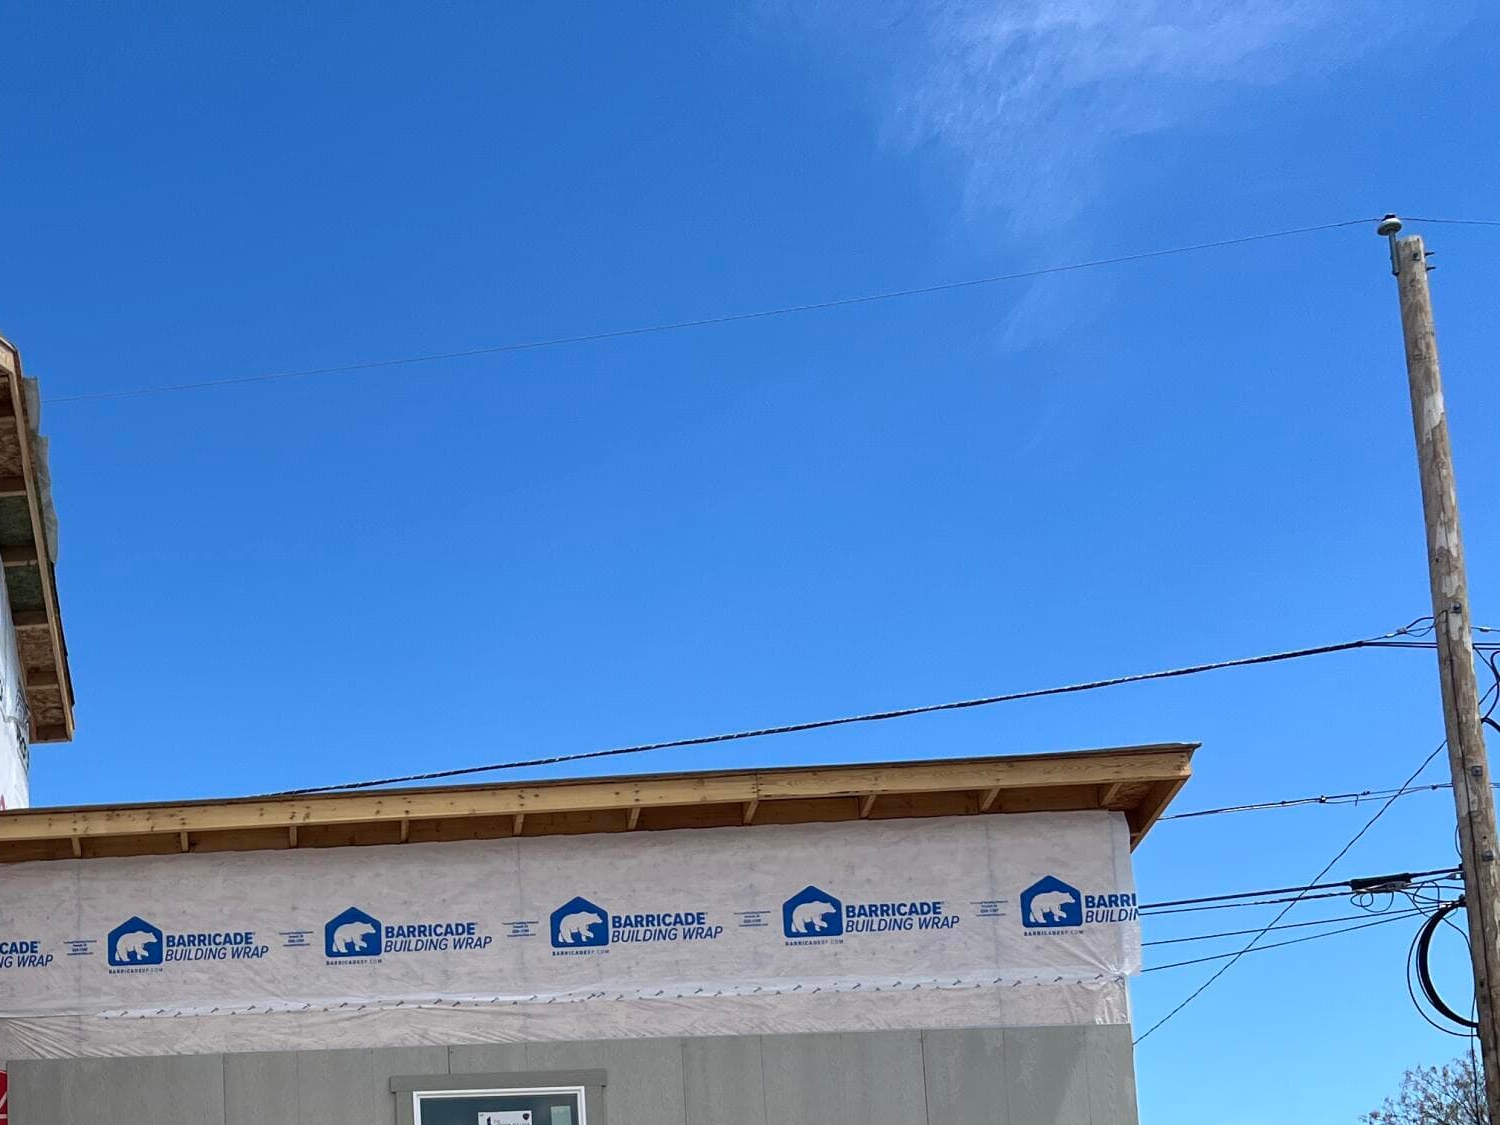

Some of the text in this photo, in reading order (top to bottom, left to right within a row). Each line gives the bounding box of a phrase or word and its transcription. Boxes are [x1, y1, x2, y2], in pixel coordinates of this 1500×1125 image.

[1085, 893, 1137, 909] BARRI
[845, 901, 942, 919] BARRICADE
[611, 911, 706, 929] BARRICADE
[845, 915, 960, 933] BUILDING WRAP
[384, 922, 476, 939] BARRICADE
[611, 925, 723, 944] BUILDING WRAP
[165, 931, 253, 948] BARRICADE
[383, 936, 492, 953] BUILDING WRAP
[17, 954, 54, 968] WRAP
[164, 945, 269, 962] BUILDING WRAP
